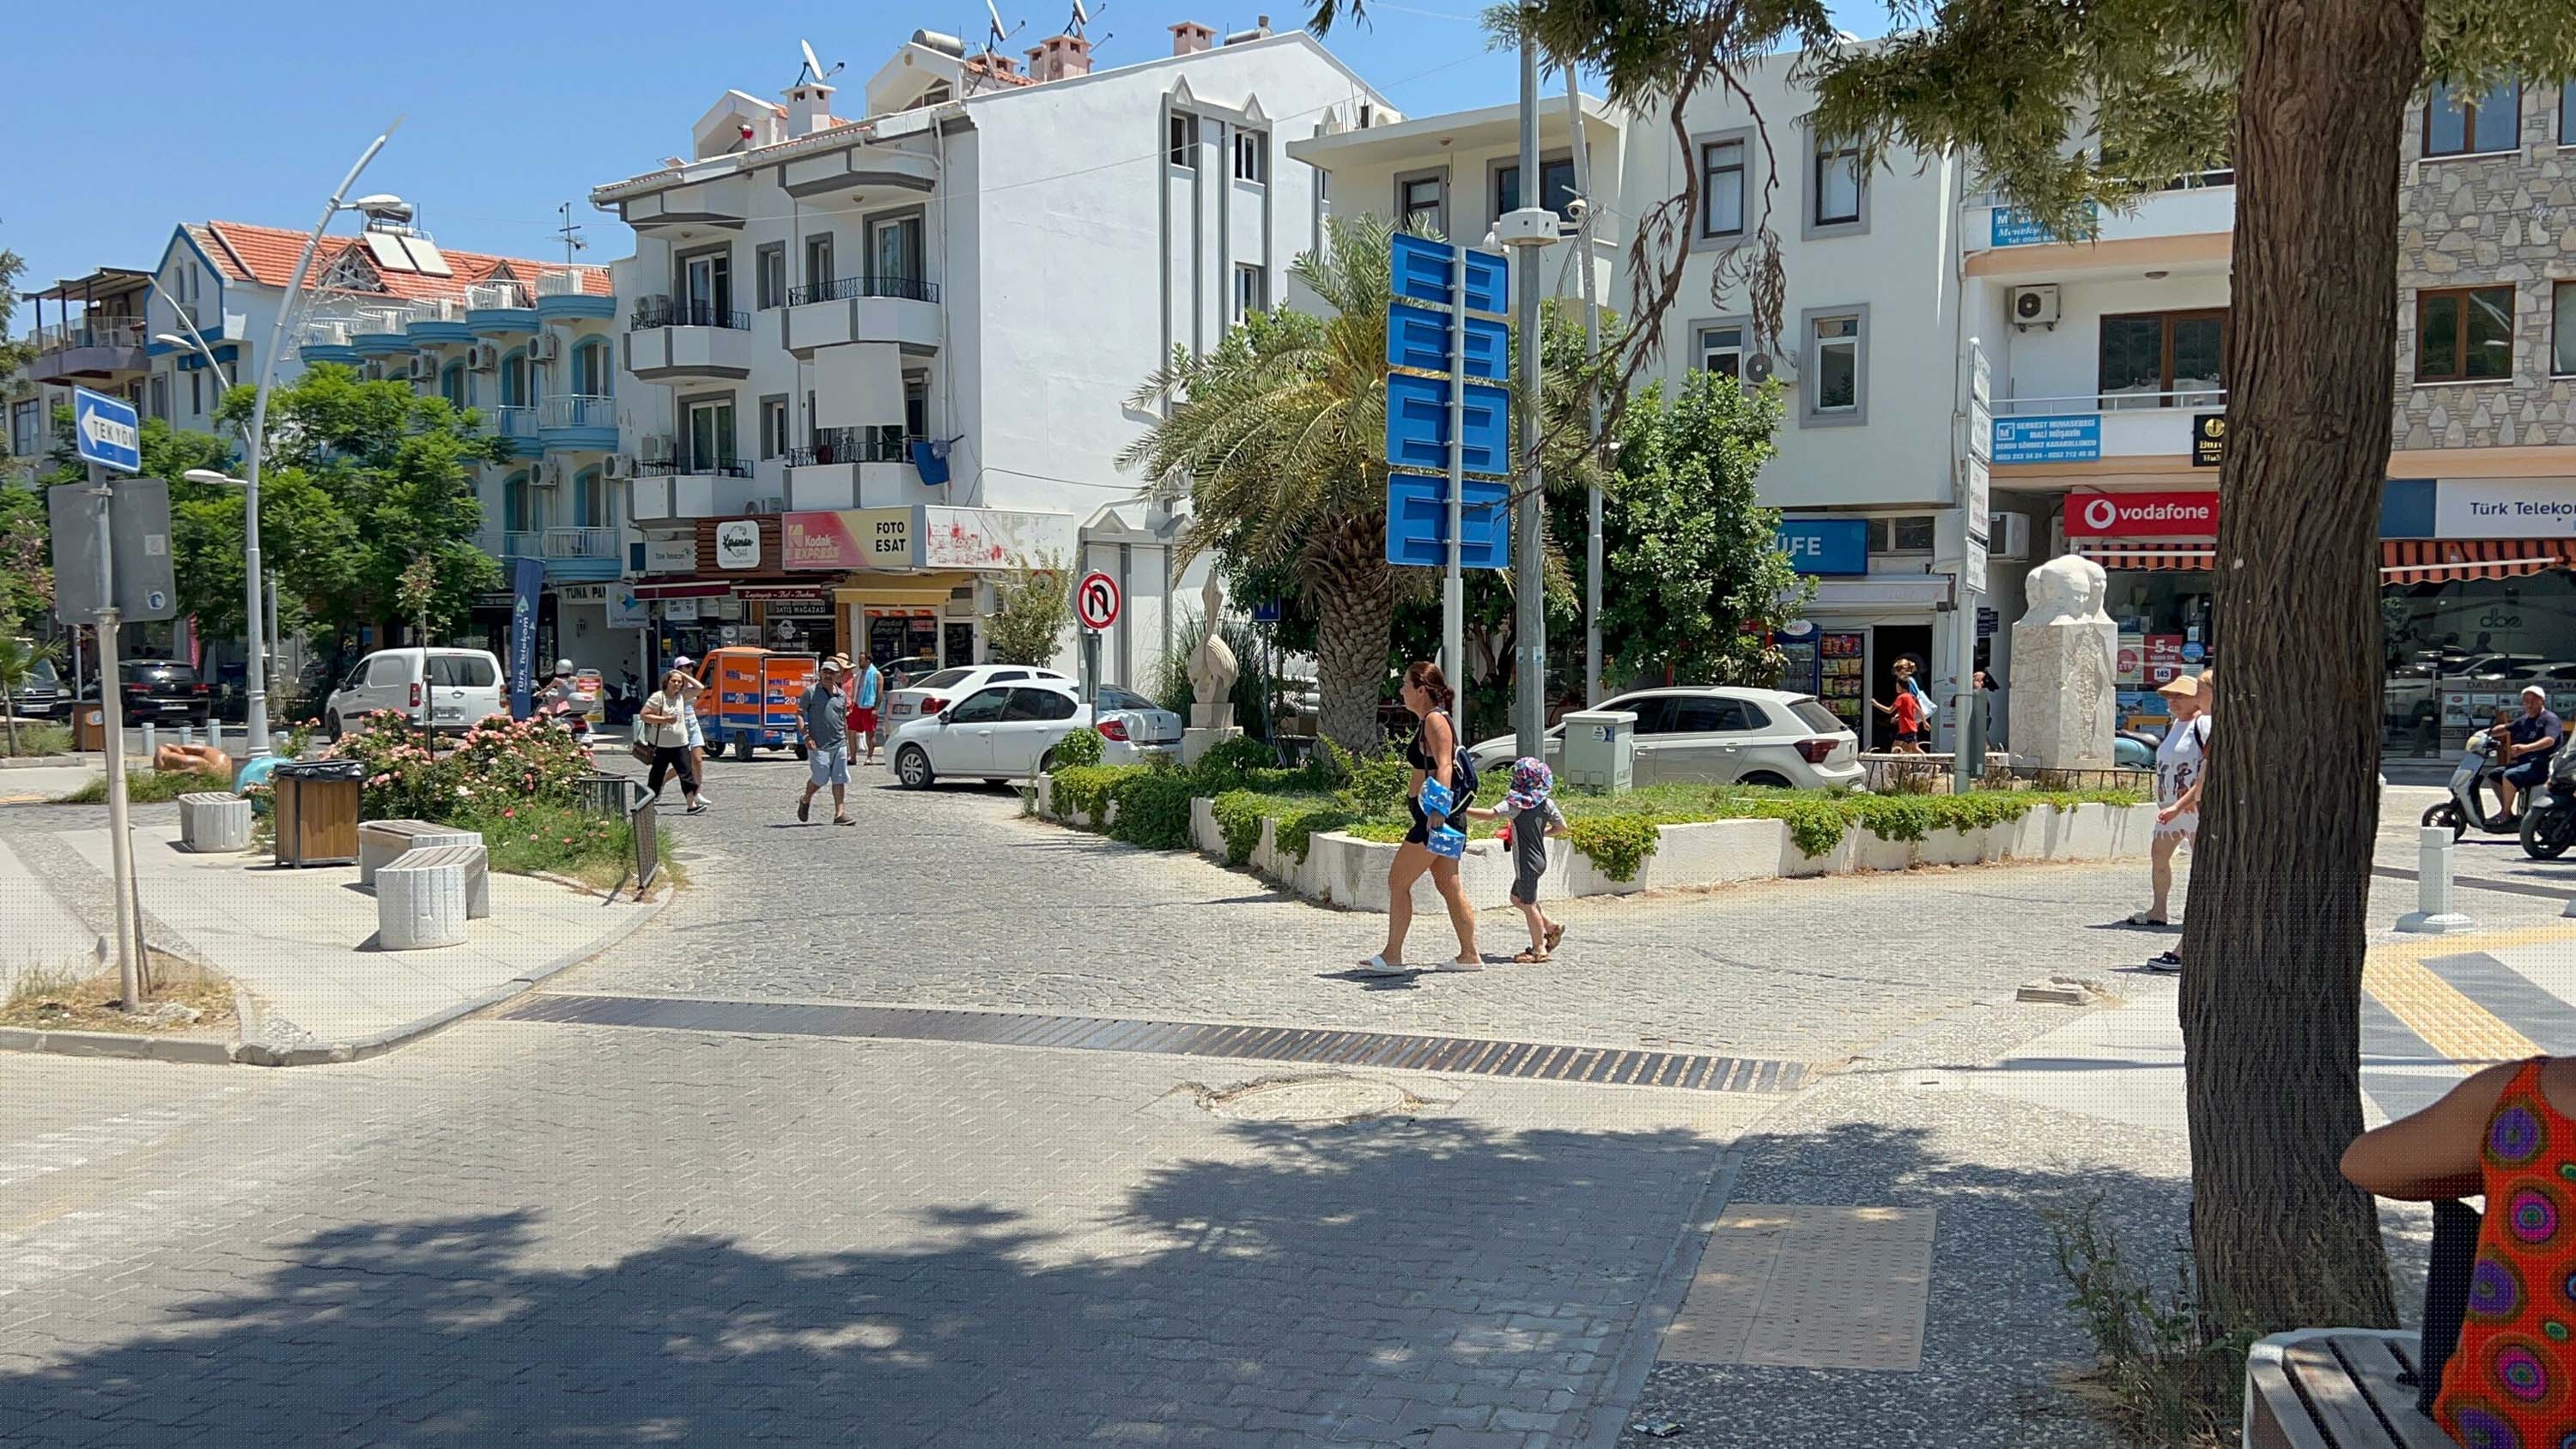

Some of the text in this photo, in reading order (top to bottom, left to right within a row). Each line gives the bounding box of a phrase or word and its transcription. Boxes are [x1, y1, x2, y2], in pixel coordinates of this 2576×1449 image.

[93, 420, 135, 446] TEK YÖN
[2119, 504, 2209, 520] vodafone
[2470, 501, 2576, 515] Türk Teleko
[877, 522, 905, 535] FOTO
[805, 535, 831, 547] Kodak
[876, 539, 906, 552] ESAT
[1762, 532, 1821, 555] ÜFE
[565, 586, 587, 599] TUNA
[520, 616, 531, 664] Telekom
[2155, 640, 2166, 653] 5
